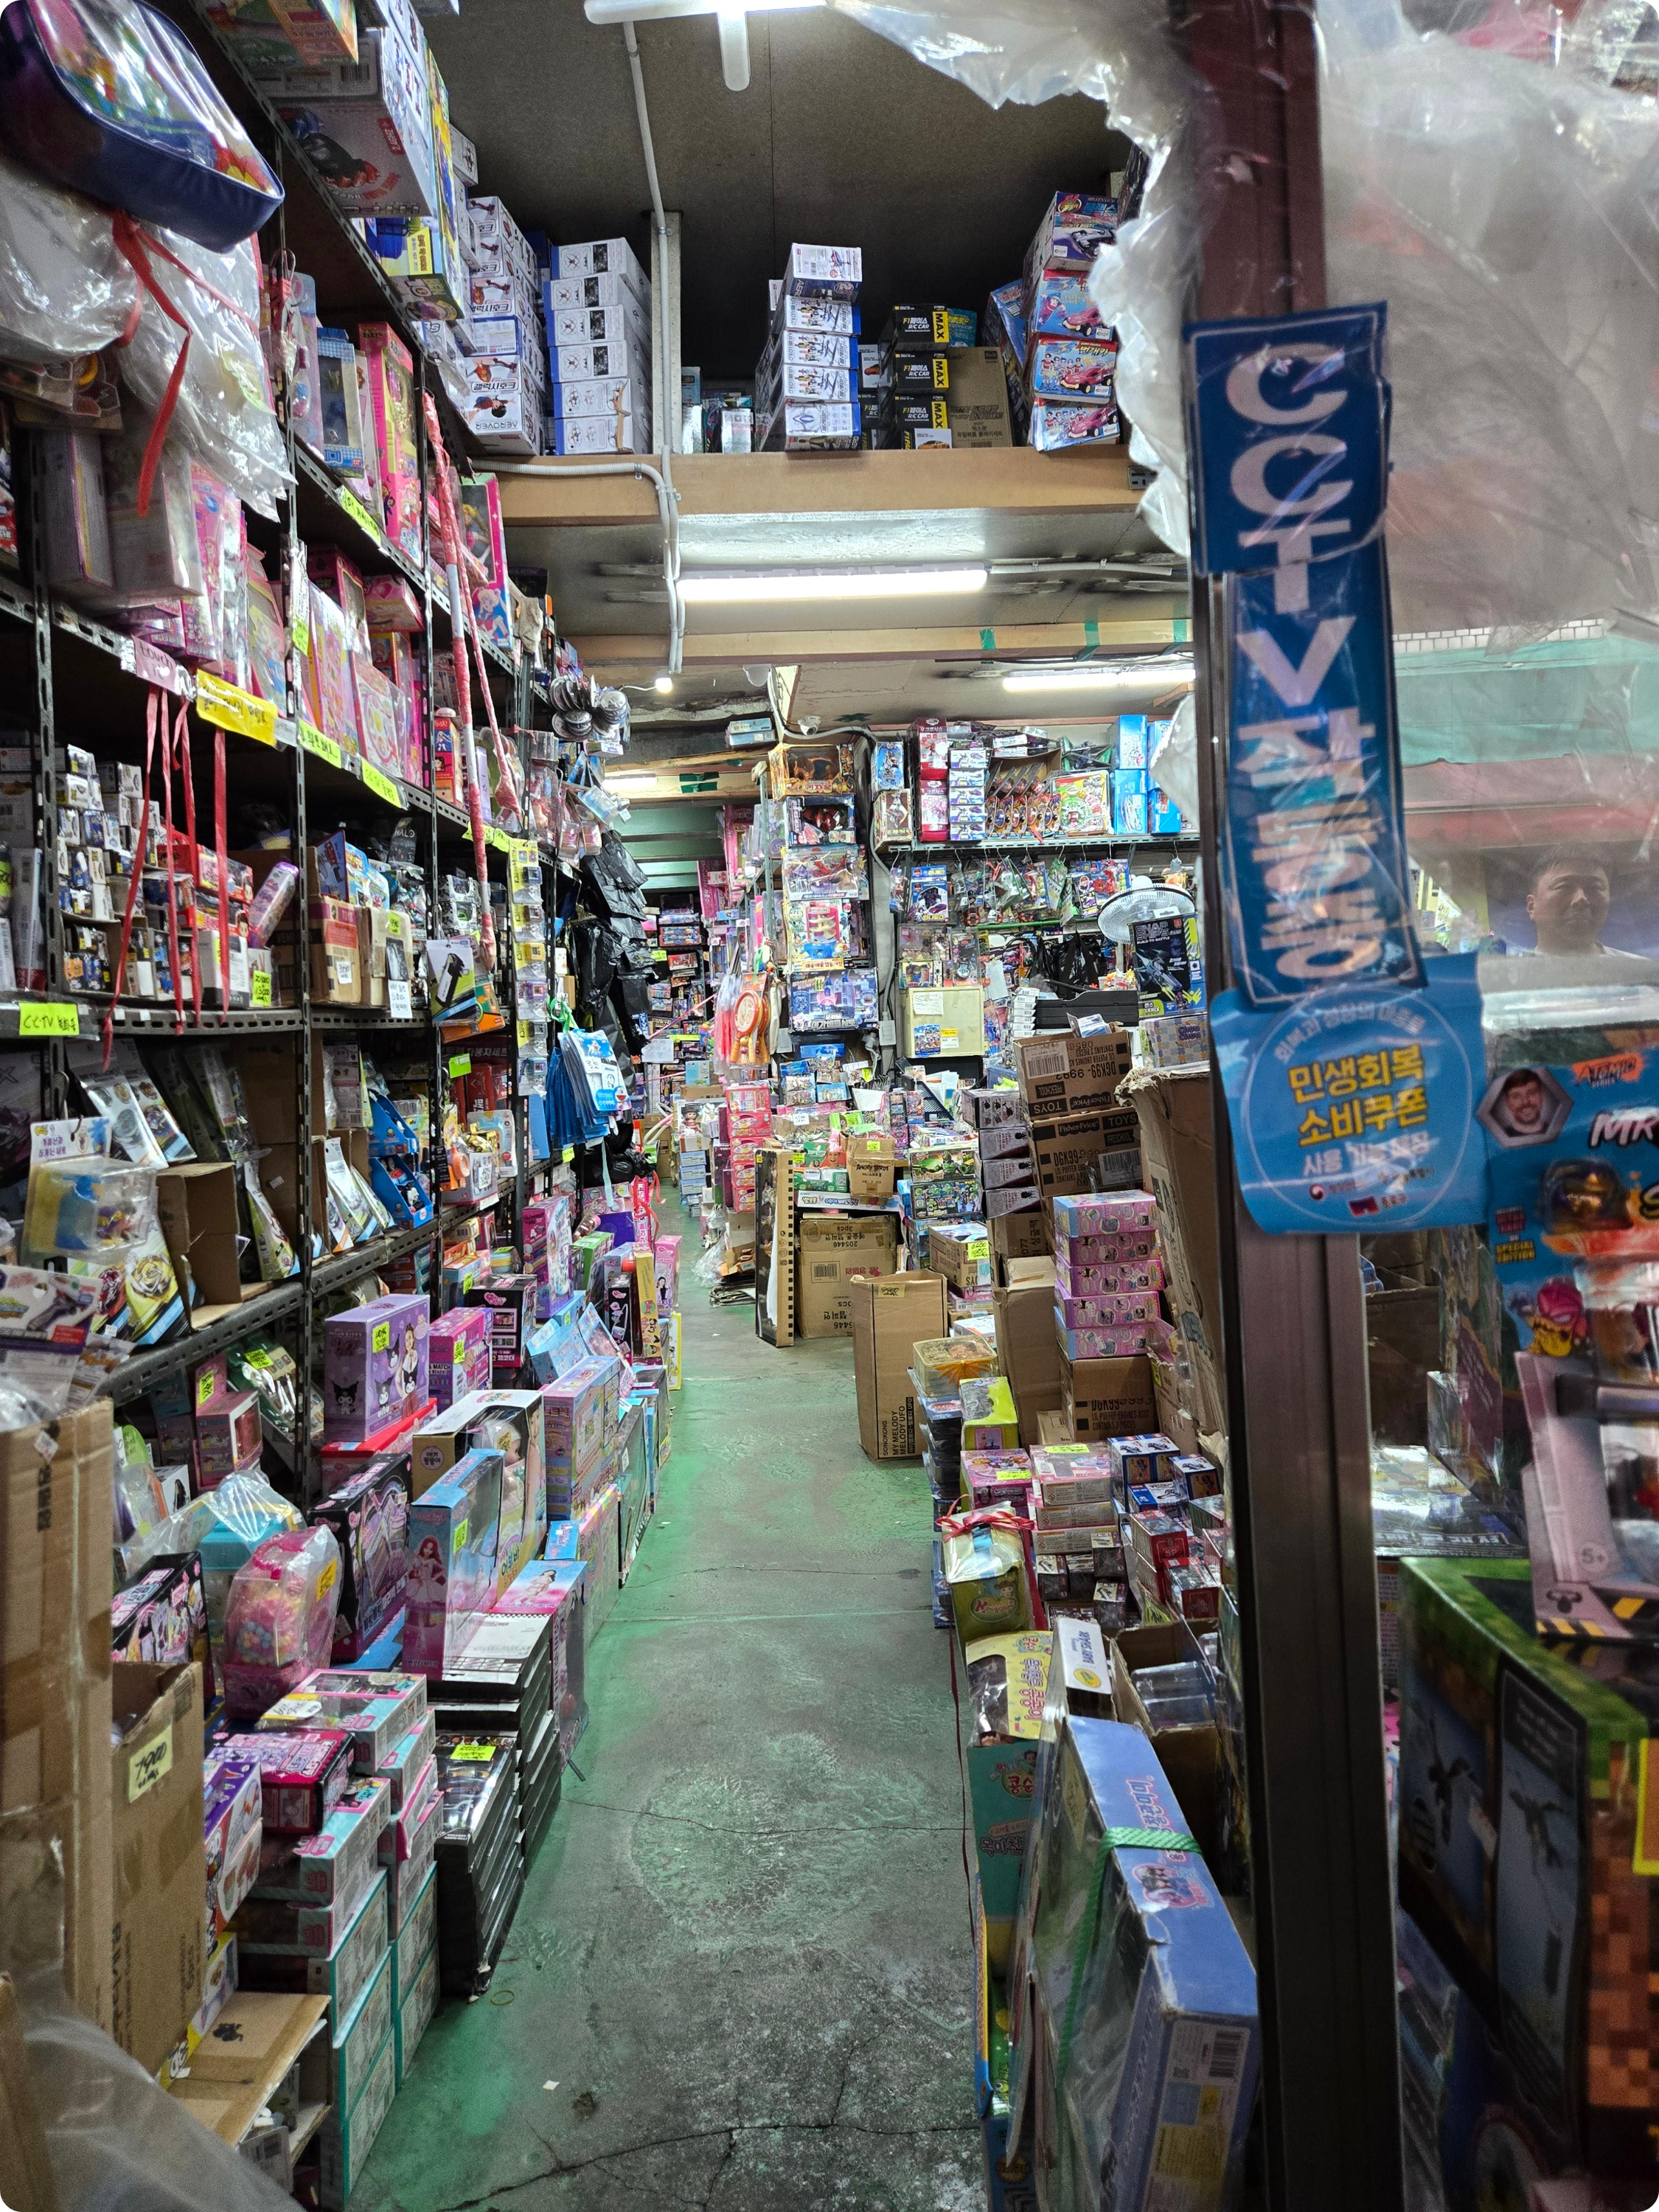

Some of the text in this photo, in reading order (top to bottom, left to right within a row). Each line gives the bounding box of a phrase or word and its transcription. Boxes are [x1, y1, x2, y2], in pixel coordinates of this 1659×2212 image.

[934, 312, 945, 340] MAX
[935, 360, 945, 386] MAX
[933, 403, 943, 428] MAX
[394, 830, 416, 838] HALO
[1287, 1043, 1425, 1105] 민생회복
[1033, 1102, 1063, 1114] TOYS
[1108, 1114, 1137, 1126] TOYS
[1297, 1085, 1429, 1148] 소비쿠폰
[856, 1164, 874, 1172] ANGRY
[824, 1310, 847, 1321] 챔피언
[891, 1411, 900, 1455] MY MELODY
[898, 1405, 907, 1455] MELODY UFO
